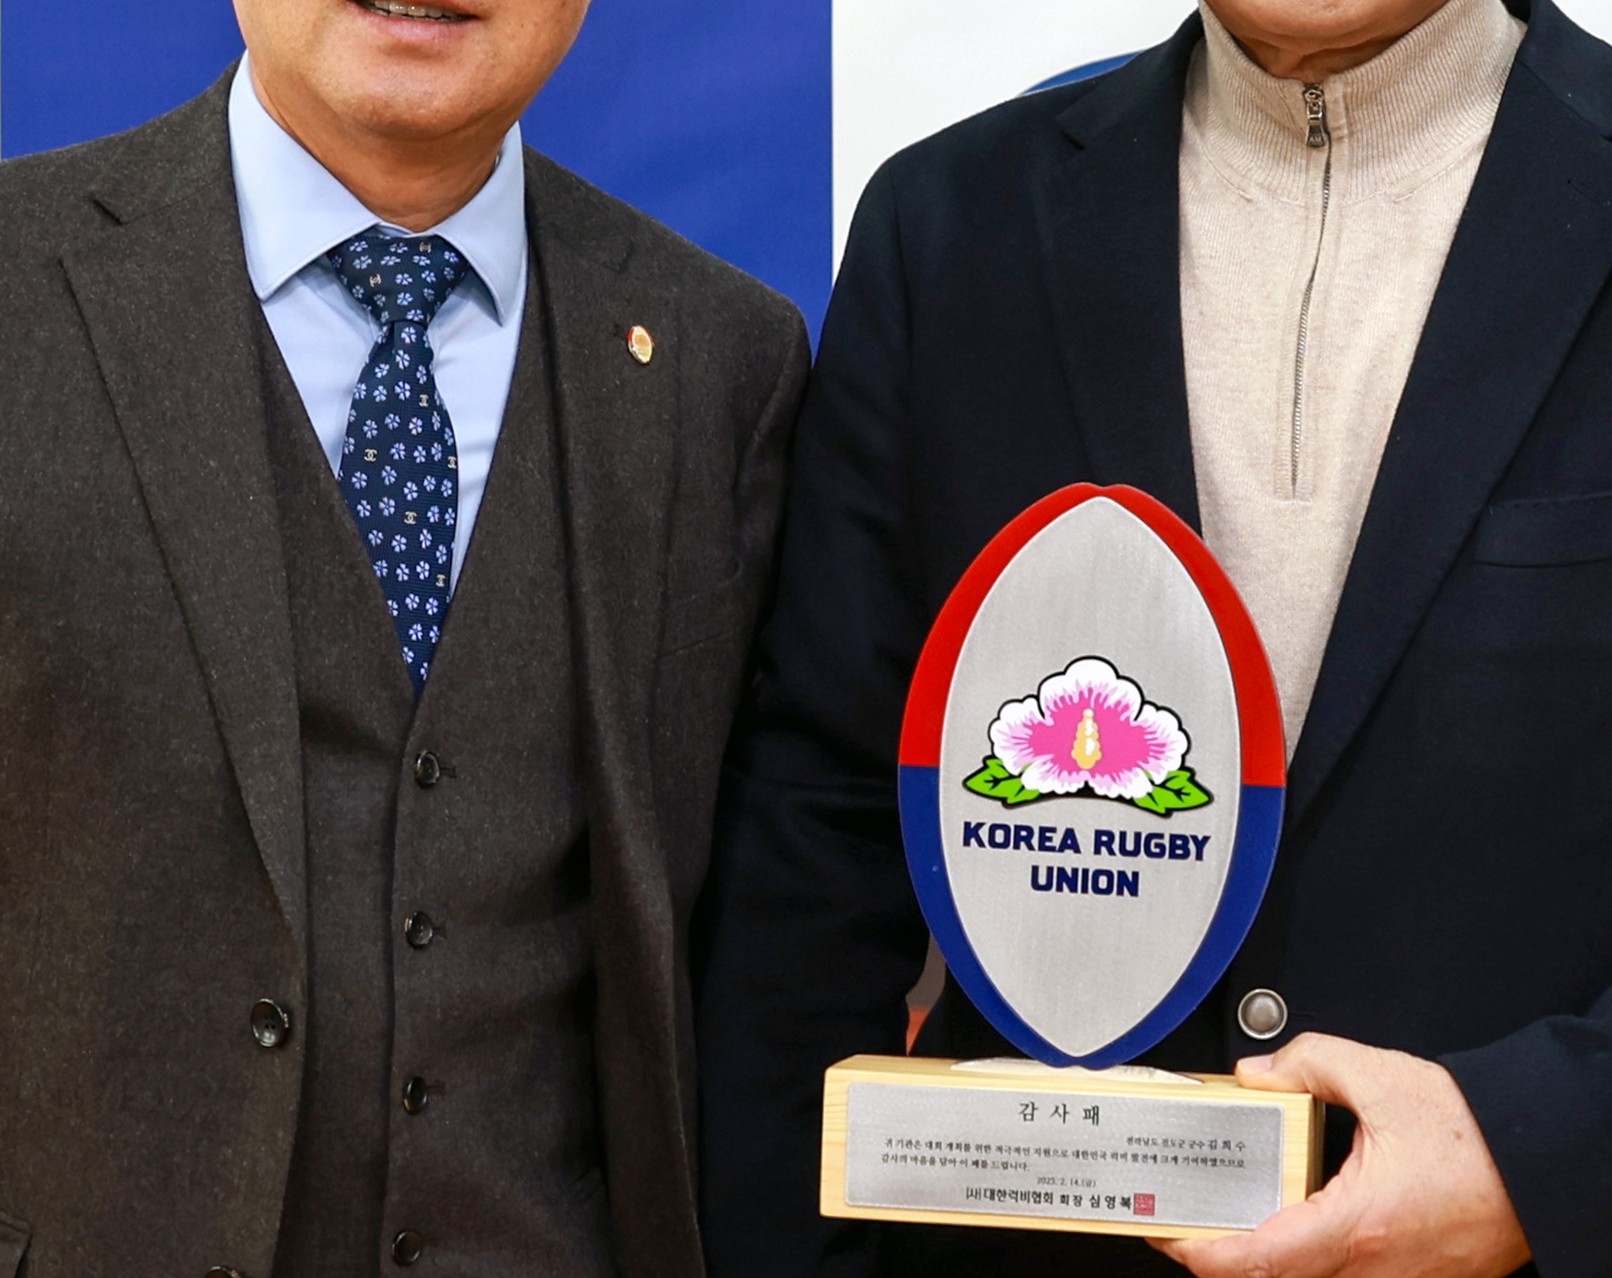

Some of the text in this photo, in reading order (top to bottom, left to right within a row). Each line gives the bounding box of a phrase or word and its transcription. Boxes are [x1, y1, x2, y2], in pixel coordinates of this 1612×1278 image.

[962, 820, 1212, 862] KOREA RUGBY
[1030, 865, 1140, 898] UNION
[896, 1139, 923, 1150] 기관은
[925, 1140, 943, 1151] 대회
[975, 1143, 992, 1154] 위한
[995, 1144, 1031, 1156] 적극적인
[1033, 1146, 1069, 1158] 지원으로
[1072, 1149, 1108, 1161] 대한민국
[1131, 1153, 1158, 1164] 발전에
[1160, 1154, 1179, 1166] 크게
[1126, 1135, 1158, 1147] 전라남도
[1161, 1138, 1186, 1149] 진도군
[1189, 1139, 1206, 1150] 군수
[881, 1154, 908, 1165] 감사의
[910, 1155, 937, 1166] 마음을
[939, 1157, 957, 1167] 담아
[959, 1158, 968, 1168] 이
[1059, 1193, 1084, 1208] 회장
